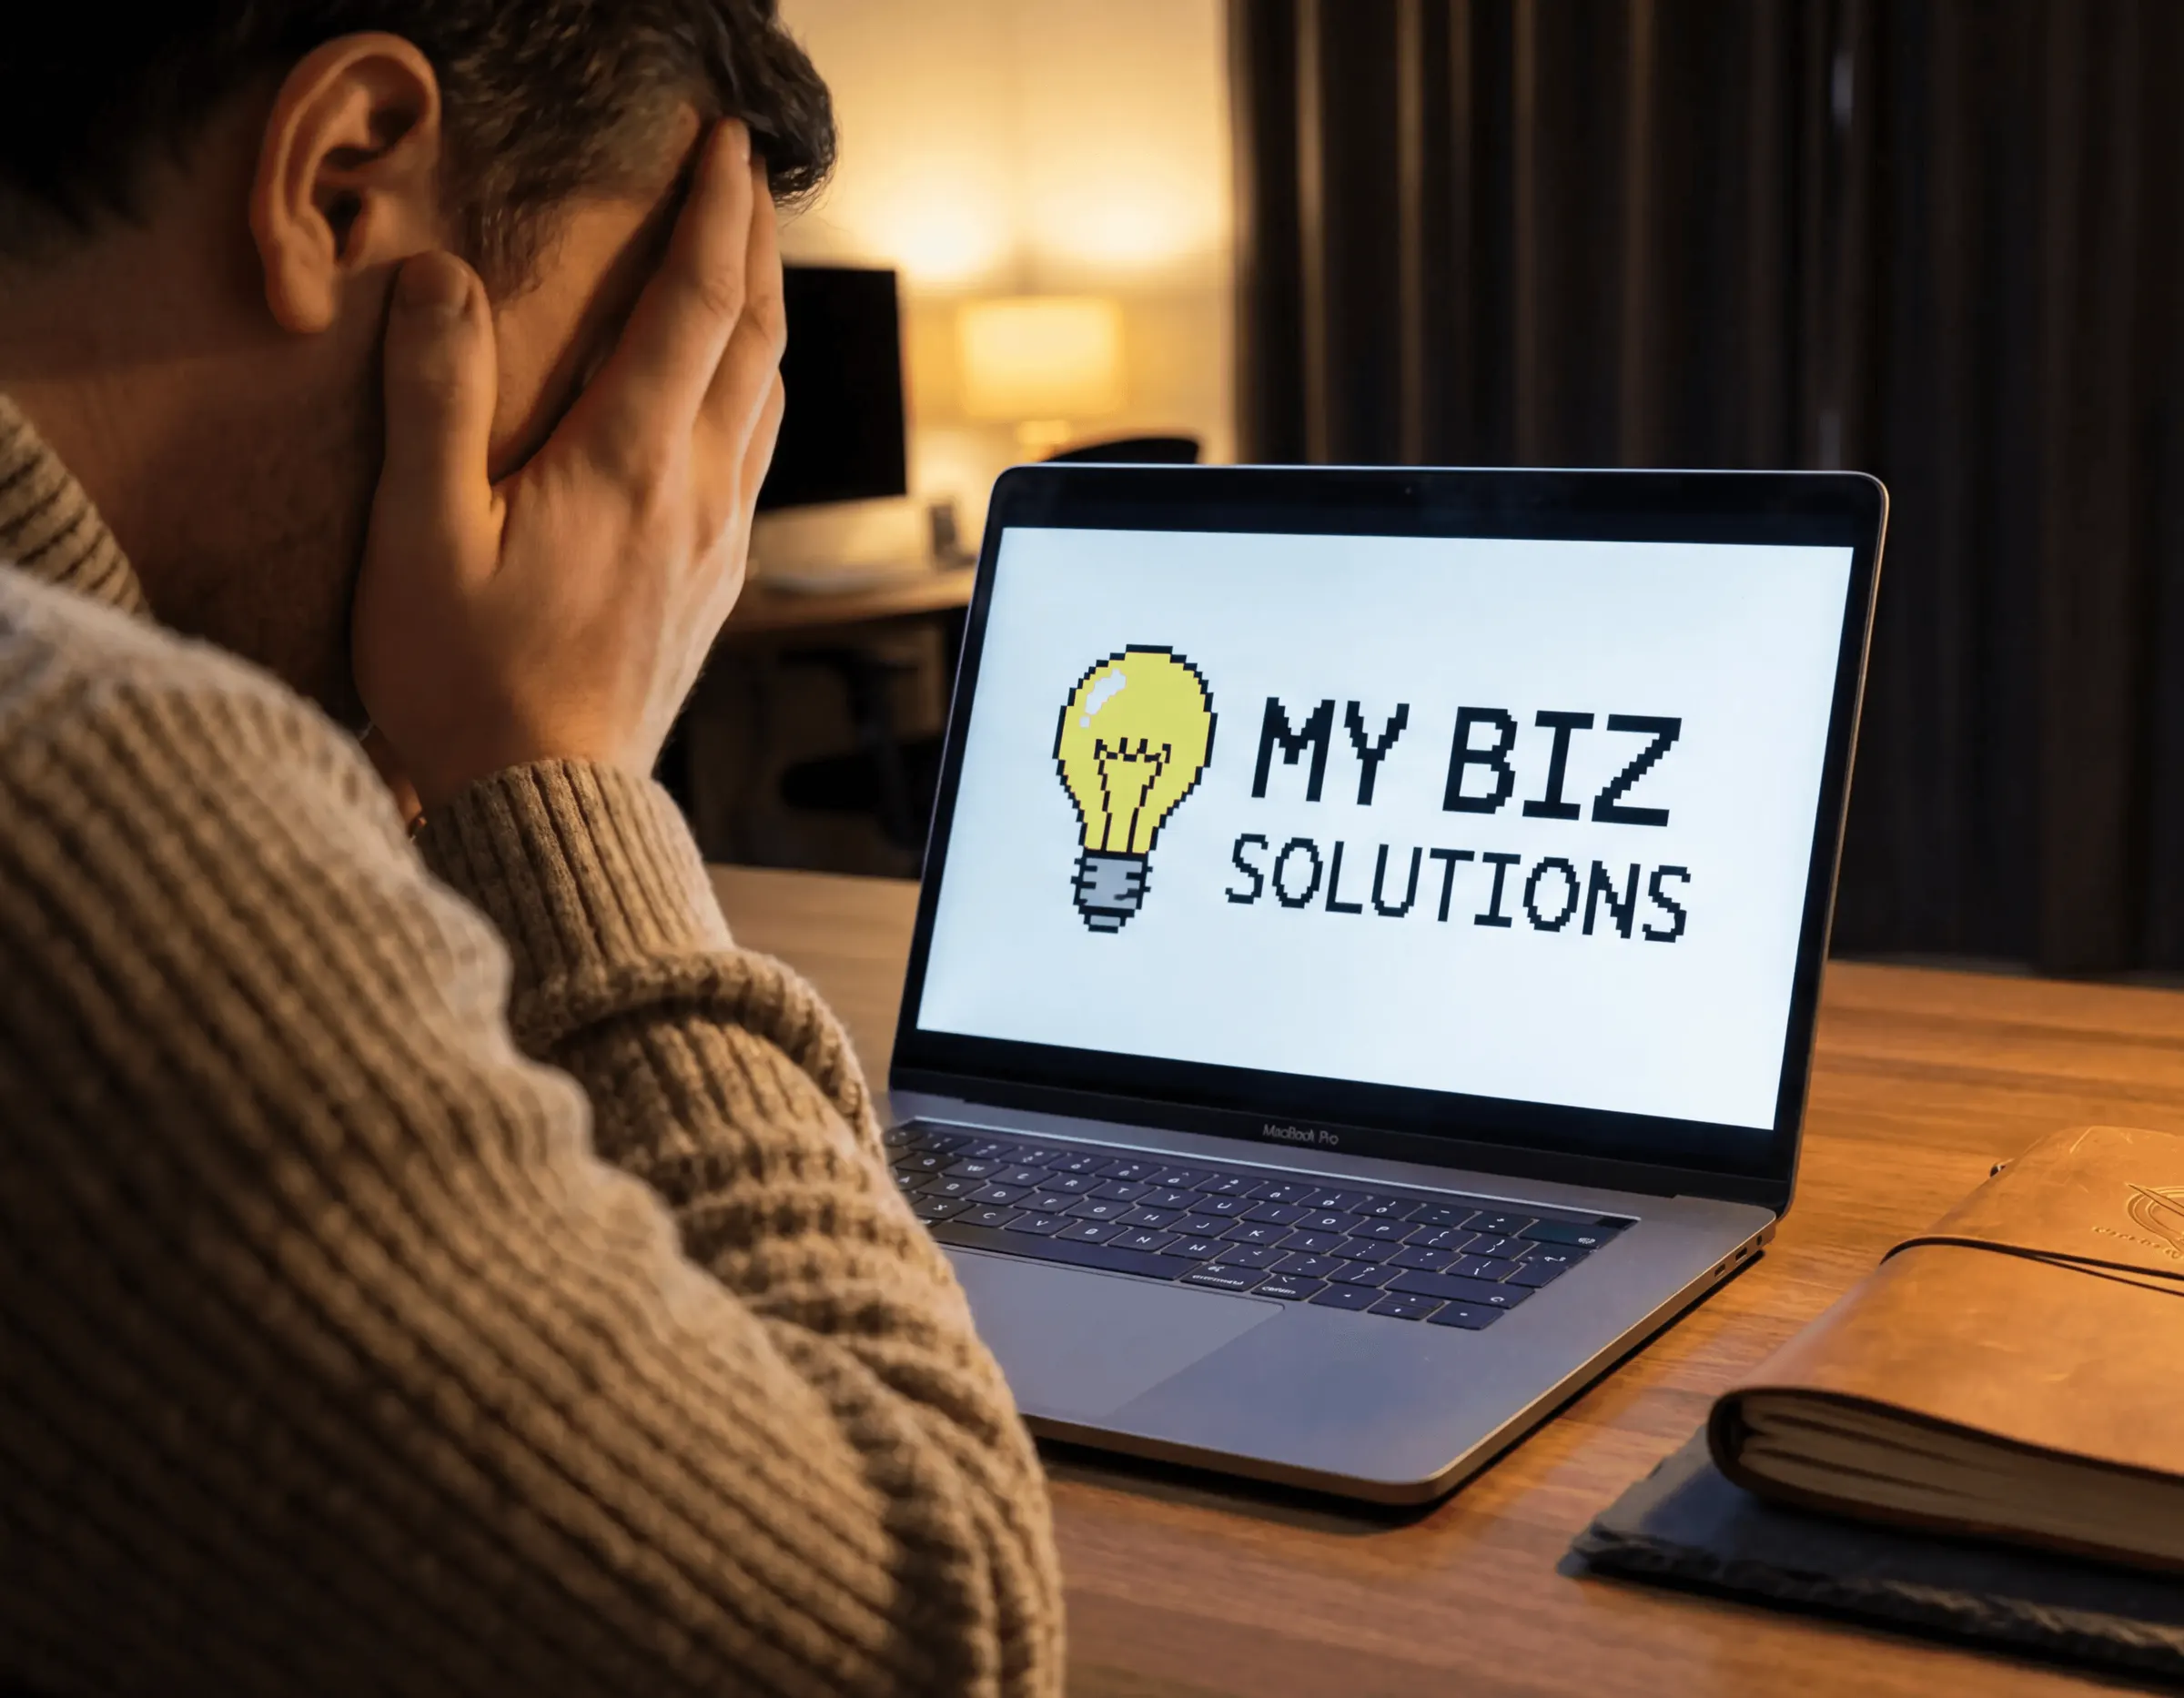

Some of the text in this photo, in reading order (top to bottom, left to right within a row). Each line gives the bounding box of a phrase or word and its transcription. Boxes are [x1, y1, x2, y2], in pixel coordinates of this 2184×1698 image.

[1251, 696, 1683, 827] MY BIZ
[1224, 833, 1692, 944] SOLUTIONS
[1262, 1124, 1340, 1146] MacBook Pro
